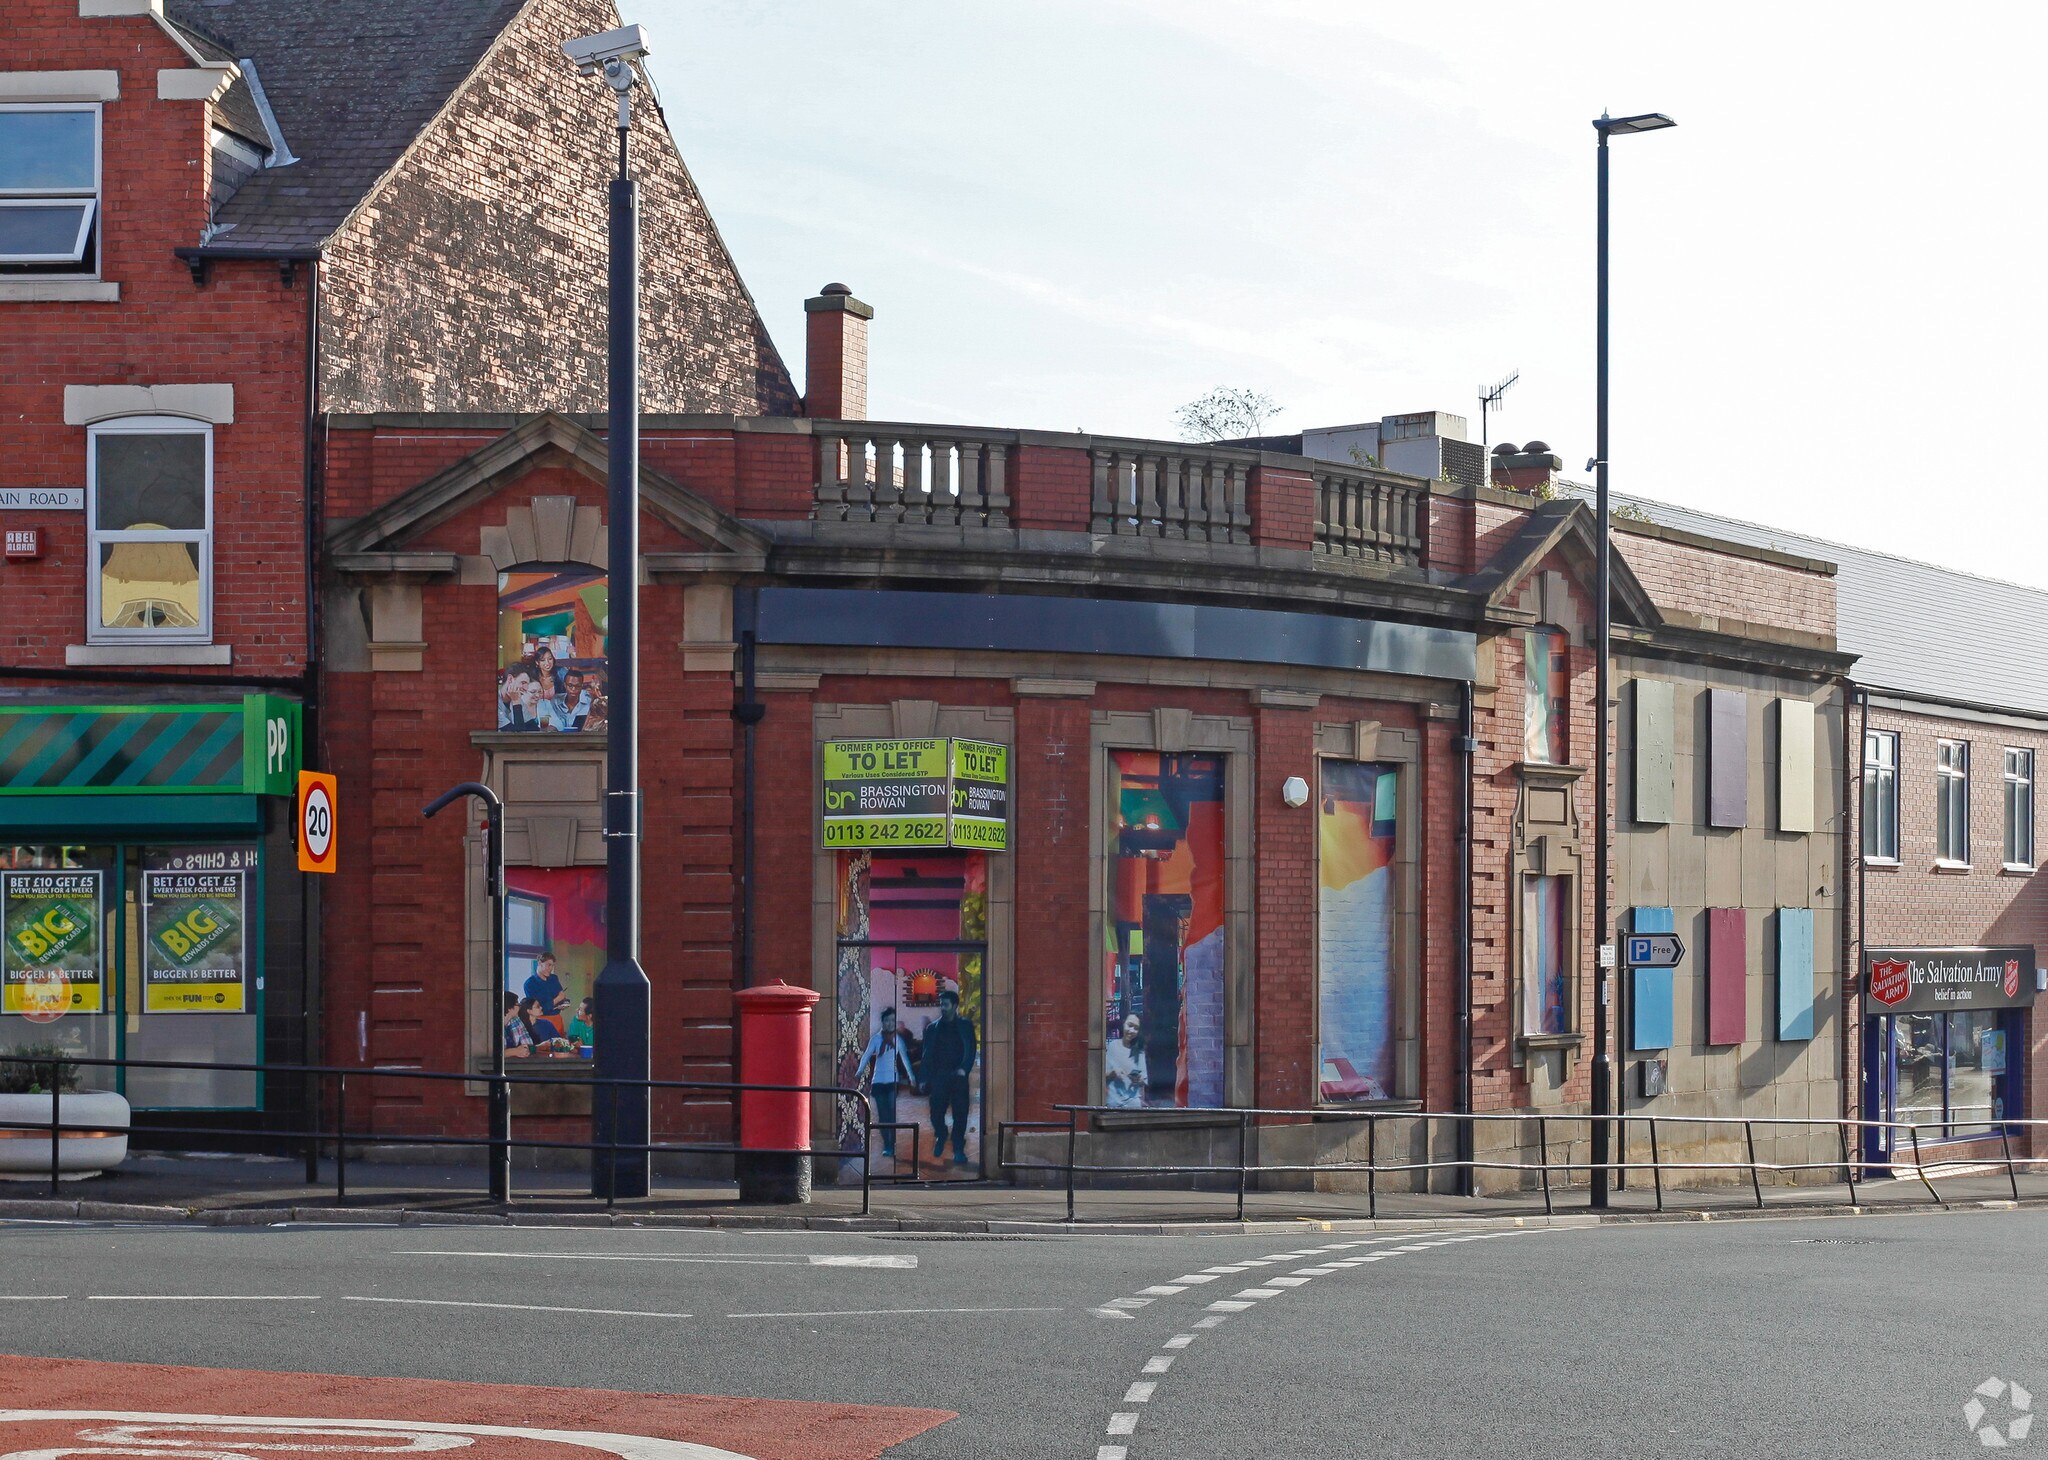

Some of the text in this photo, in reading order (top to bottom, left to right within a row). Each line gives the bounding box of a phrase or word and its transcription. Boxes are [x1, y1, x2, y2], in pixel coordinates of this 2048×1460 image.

[30, 492, 68, 504] ROAD
[7, 532, 35, 542] ABEL
[267, 717, 288, 774] PP
[835, 741, 935, 752] FORMER POST OFFICE
[958, 742, 1002, 756] FORMER POST OFFICE
[848, 751, 922, 770] TO LET
[964, 753, 996, 774] TO LET
[825, 787, 855, 810] br
[860, 784, 946, 798] BRASSINGTON
[952, 784, 967, 808] br
[969, 787, 1006, 801] BRASSINGTON
[860, 797, 906, 809] ROWAN
[968, 798, 990, 811] ROWAN
[308, 804, 328, 837] 20
[826, 823, 944, 841] 0113 242 2622
[953, 823, 1005, 843] 0113 242 2622
[10, 877, 93, 887] BET £10 GET £5
[154, 876, 236, 886] BET £10 GET £5
[17, 909, 74, 957] BIG
[160, 909, 218, 957] BIG
[38, 928, 81, 964] REWARDS CARD
[182, 927, 224, 962] REWARDS CARD
[1636, 942, 1648, 959] P
[10, 970, 94, 979] BIGGER IS BETTER
[154, 969, 236, 979] BIGGER IS BETTER
[1879, 965, 1892, 978] THE
[1927, 960, 1972, 983] Salvation
[1974, 960, 2002, 988] Army
[1873, 968, 1907, 993] SALVATION
[1884, 982, 1904, 1000] ARMY
[1934, 988, 1972, 1001] belief in action
